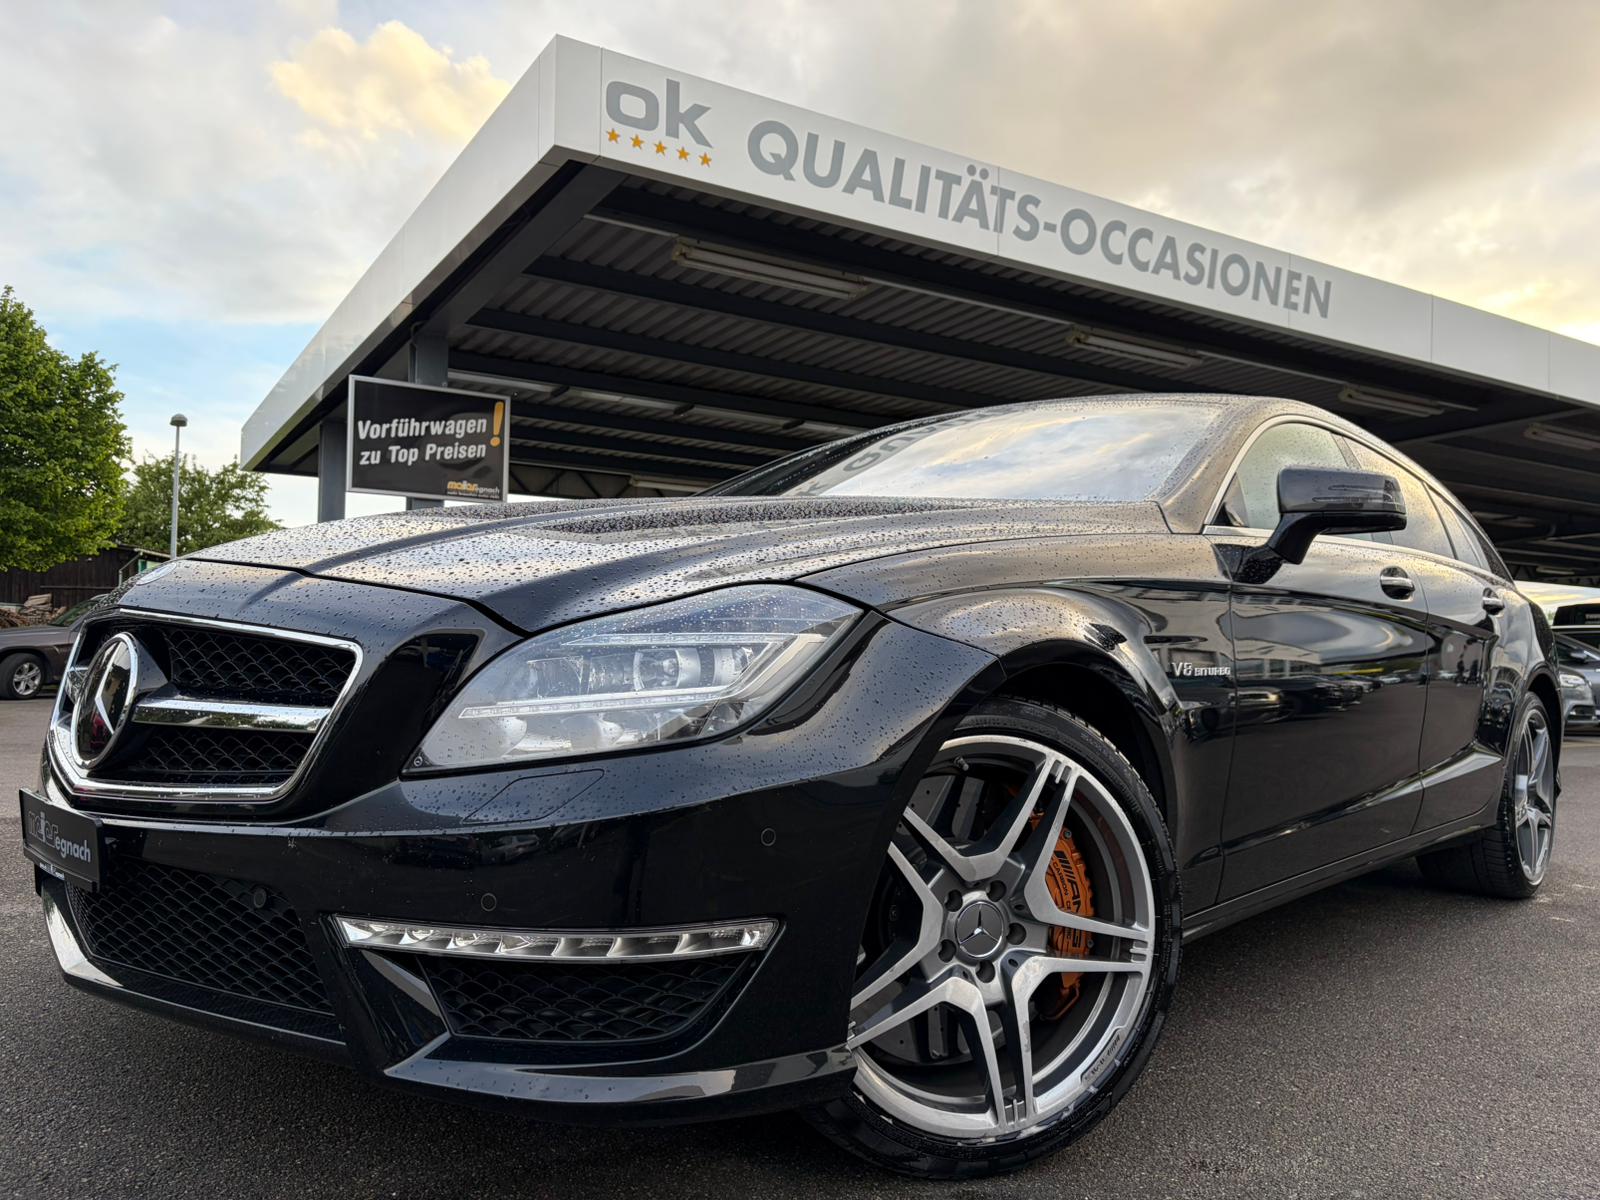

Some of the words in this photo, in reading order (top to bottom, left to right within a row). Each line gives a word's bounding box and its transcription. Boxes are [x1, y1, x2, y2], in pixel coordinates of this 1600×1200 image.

[605, 78, 713, 149] ok
[747, 119, 1332, 318] QUALITÄTS-OCCASIONEN
[357, 417, 487, 440] Vorführwagen
[359, 450, 381, 465] zu
[388, 445, 419, 466] Top
[425, 442, 486, 461] Preisen
